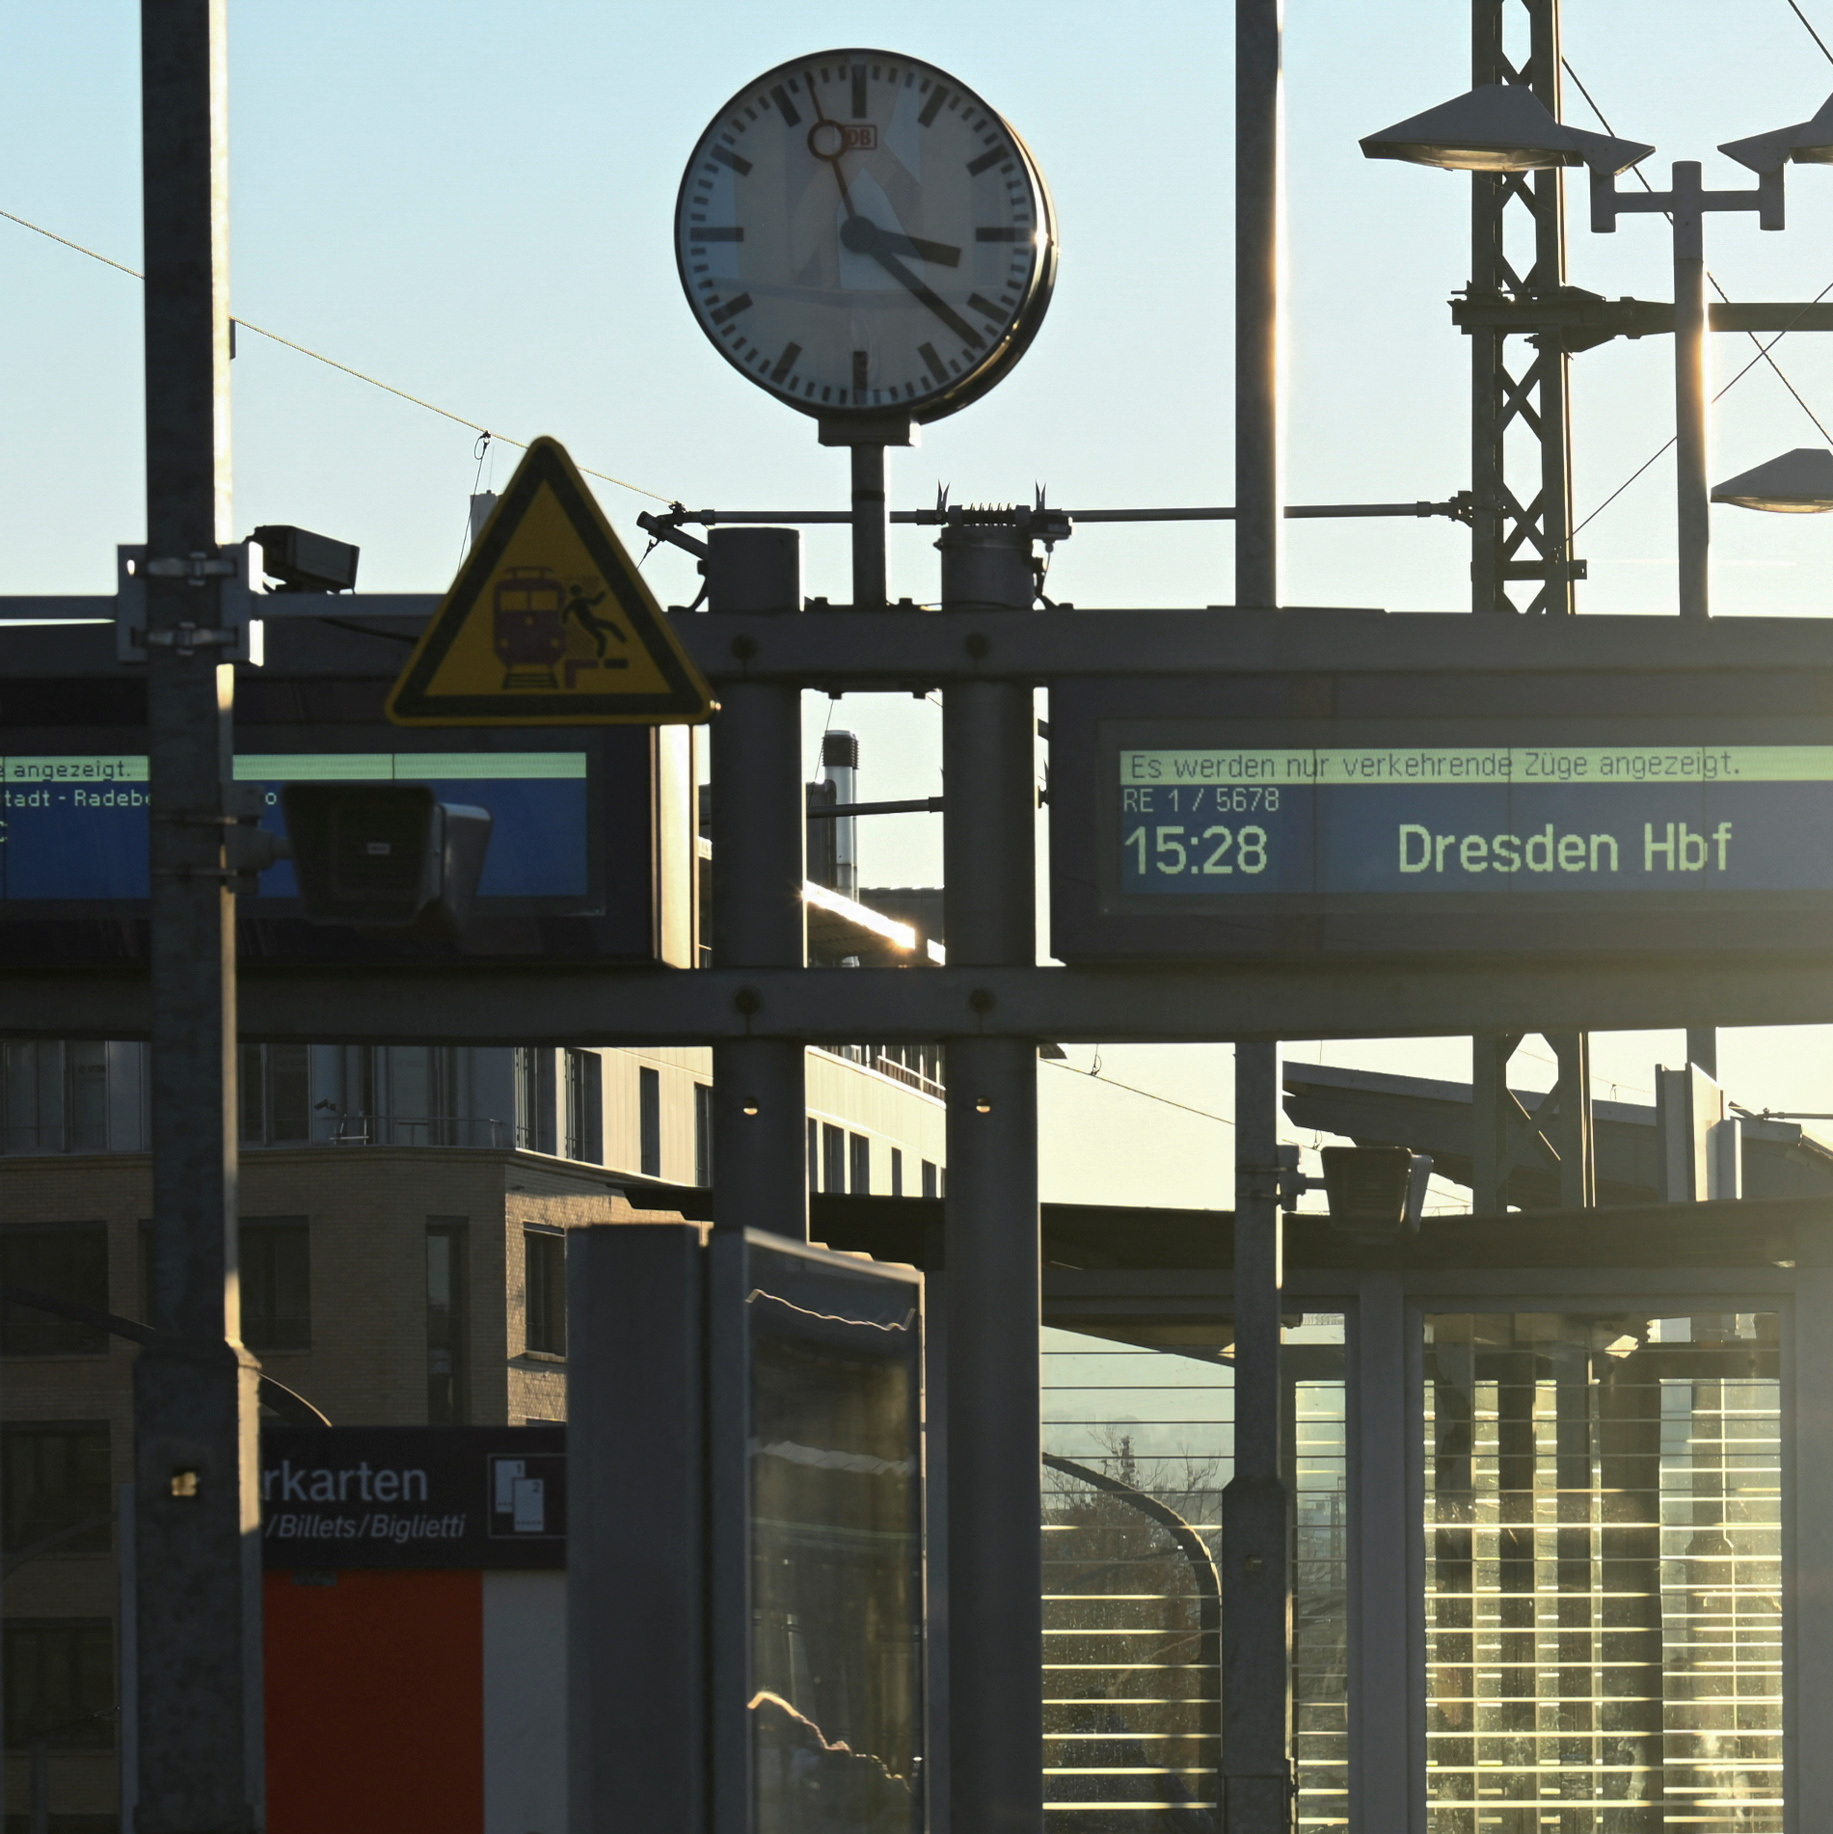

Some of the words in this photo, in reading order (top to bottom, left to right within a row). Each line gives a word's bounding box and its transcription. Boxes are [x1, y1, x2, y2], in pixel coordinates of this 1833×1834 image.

[847, 128, 872, 146] DB
[13, 760, 131, 782] angezeigt.
[1131, 755, 1162, 778] Es
[1174, 755, 1275, 778] werden
[1287, 757, 1330, 777] nur
[1343, 752, 1512, 777] verkehrende
[1525, 752, 1588, 780] Züge
[1600, 751, 1740, 780] angezeigt.
[1123, 788, 1154, 812] RE
[1167, 788, 1178, 812] 1
[1192, 788, 1204, 812] /
[1216, 787, 1279, 812] 5678
[1124, 825, 1267, 874] 15:28
[1399, 823, 1619, 873] Dresden
[1644, 822, 1733, 872] Hbf
